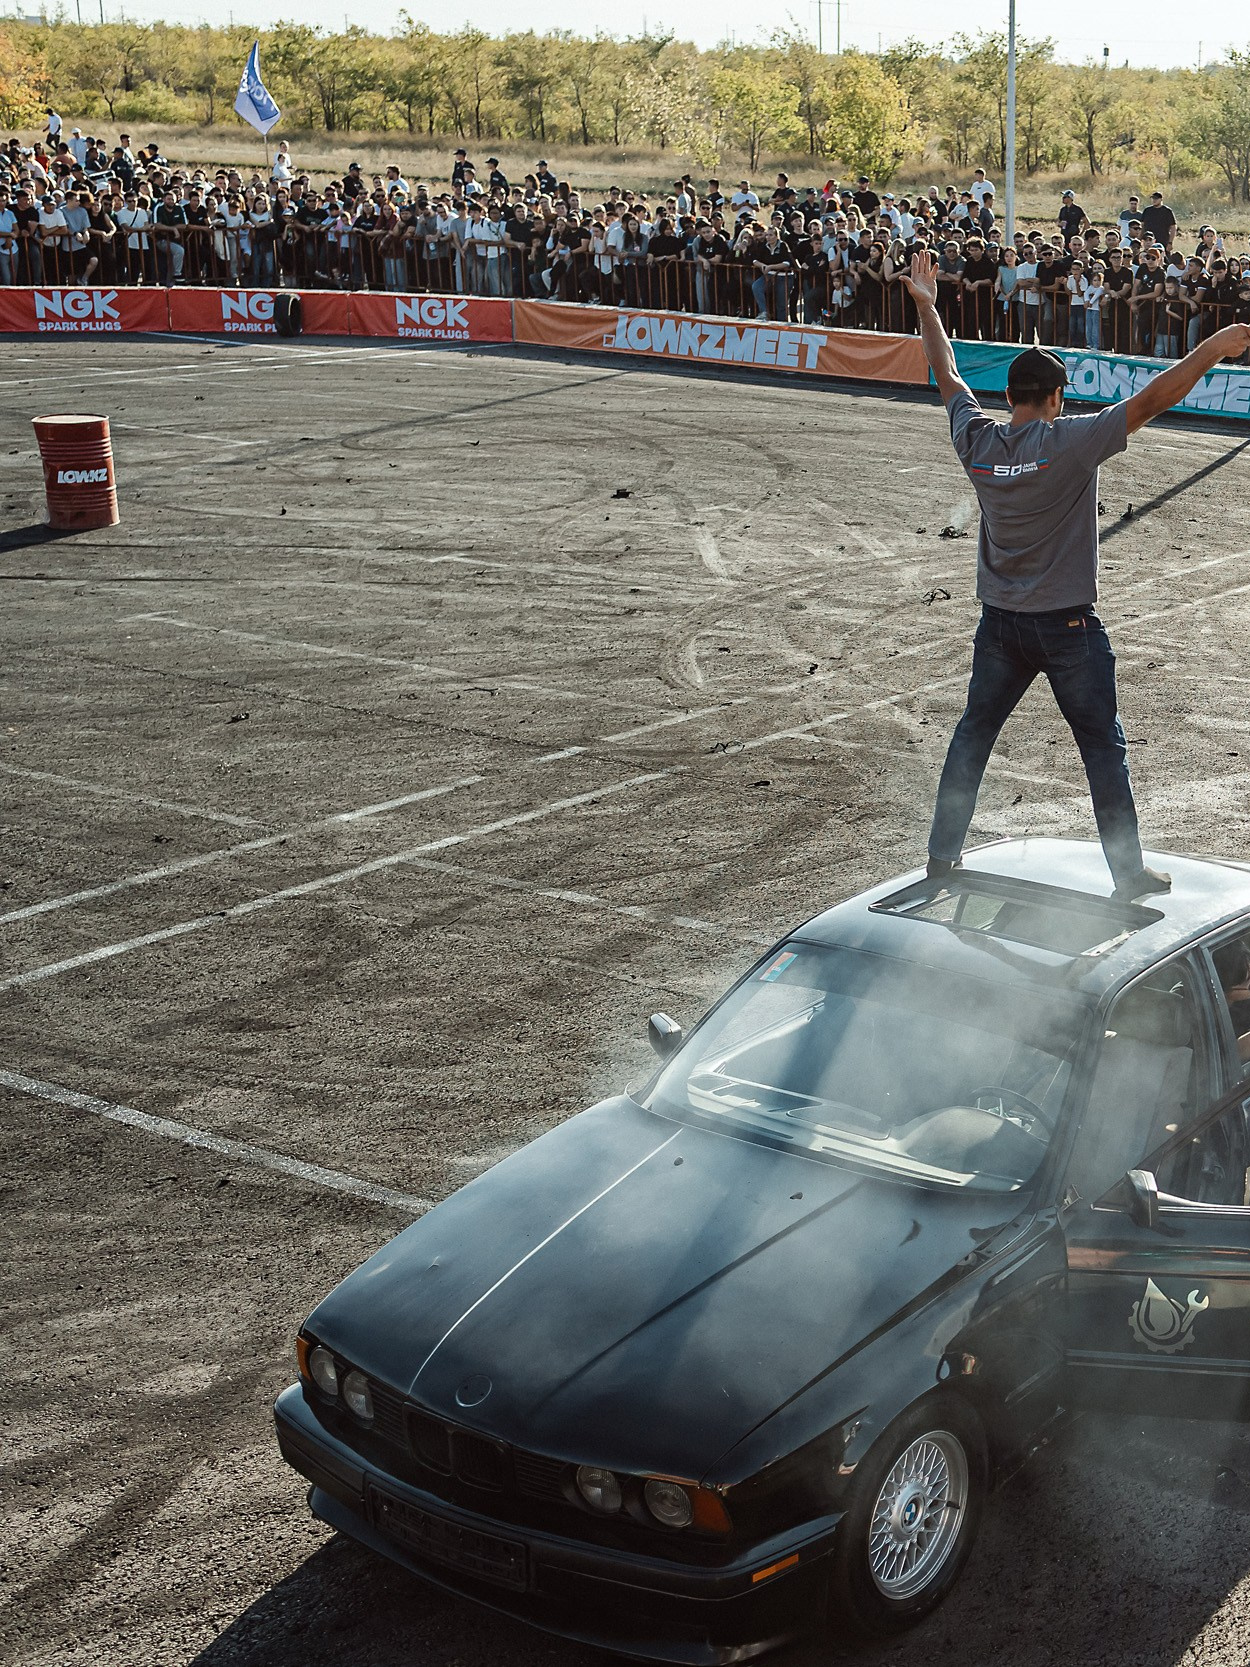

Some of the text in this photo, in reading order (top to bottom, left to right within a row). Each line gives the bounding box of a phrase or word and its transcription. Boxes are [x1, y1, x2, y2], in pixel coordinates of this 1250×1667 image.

[33, 289, 121, 319] NGK
[220, 291, 275, 321] NG
[395, 297, 469, 328] NGK
[38, 321, 122, 332] SPARK PLUGS
[224, 322, 262, 332] SPARK
[398, 327, 470, 340] SPARK PLUGS
[614, 314, 828, 370] LOWKZMEET
[57, 468, 108, 484] LOWKZ
[993, 464, 1022, 476] 50
